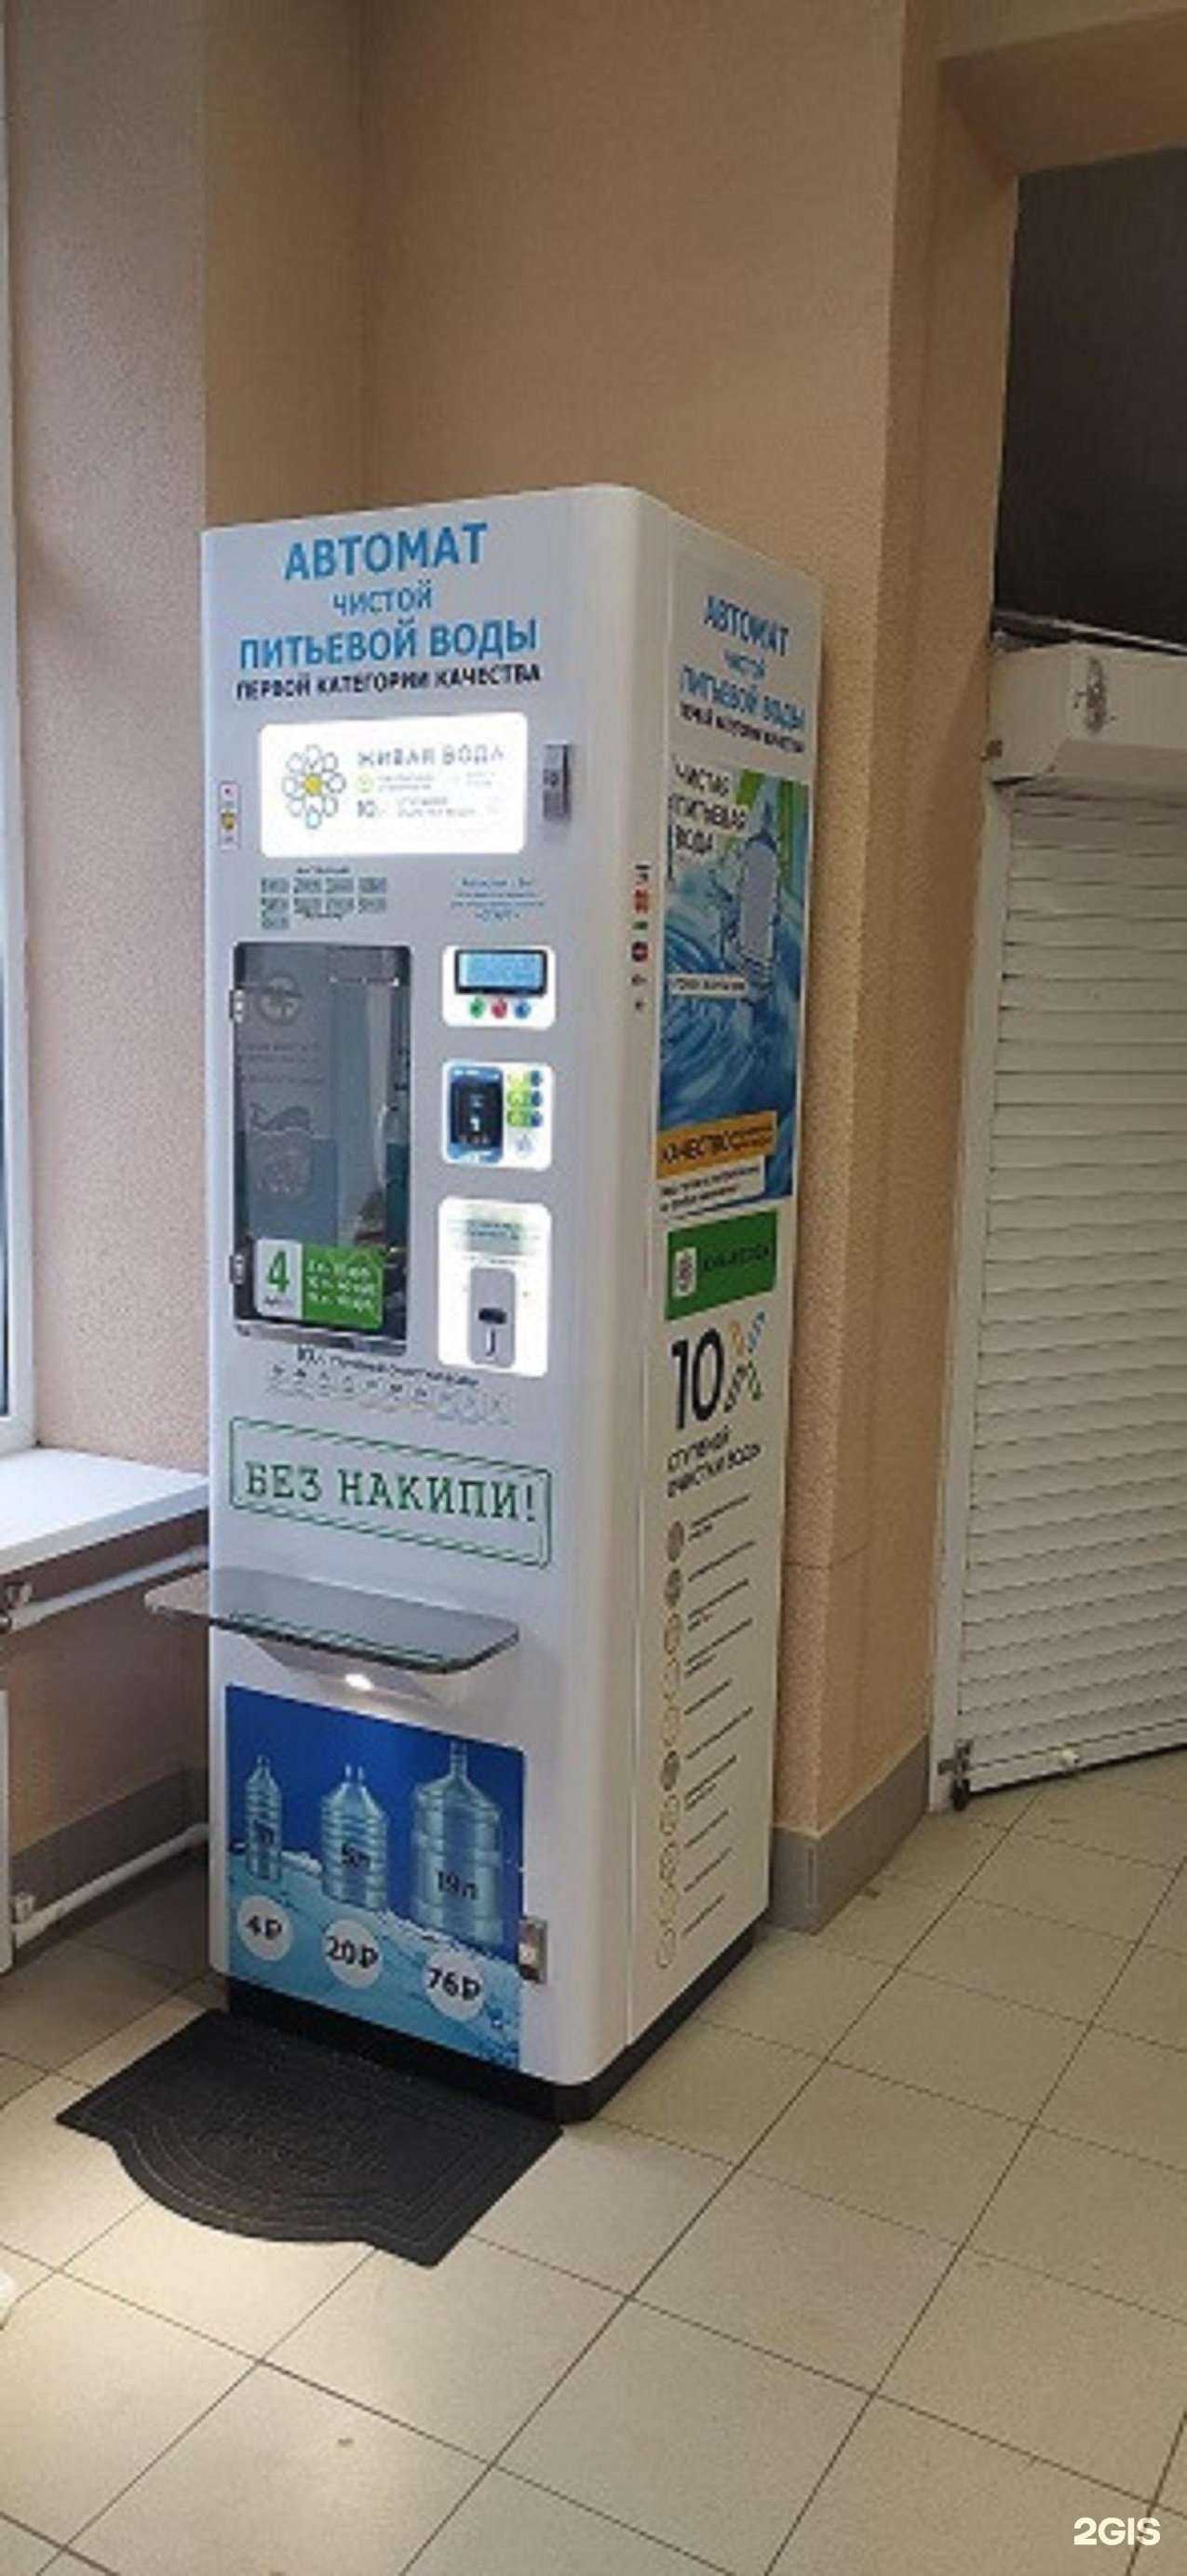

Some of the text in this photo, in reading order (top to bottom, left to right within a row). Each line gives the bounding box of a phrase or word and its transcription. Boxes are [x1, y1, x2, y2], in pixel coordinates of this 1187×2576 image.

[283, 522, 488, 581] АВТОМАТ
[332, 579, 433, 617] ЧИСТОЙ
[703, 594, 789, 657] АВТОМАТ
[239, 618, 540, 670] ПИТЬЕВОЙ ВОДЫ
[236, 662, 542, 701] ПЕРВОЙ КАТЕГОРИИ КАЧЕСТВА
[265, 1250, 290, 1294] 4
[670, 1327, 724, 1430] 10
[244, 1460, 536, 1523] БЕЗ НАКИПИ!
